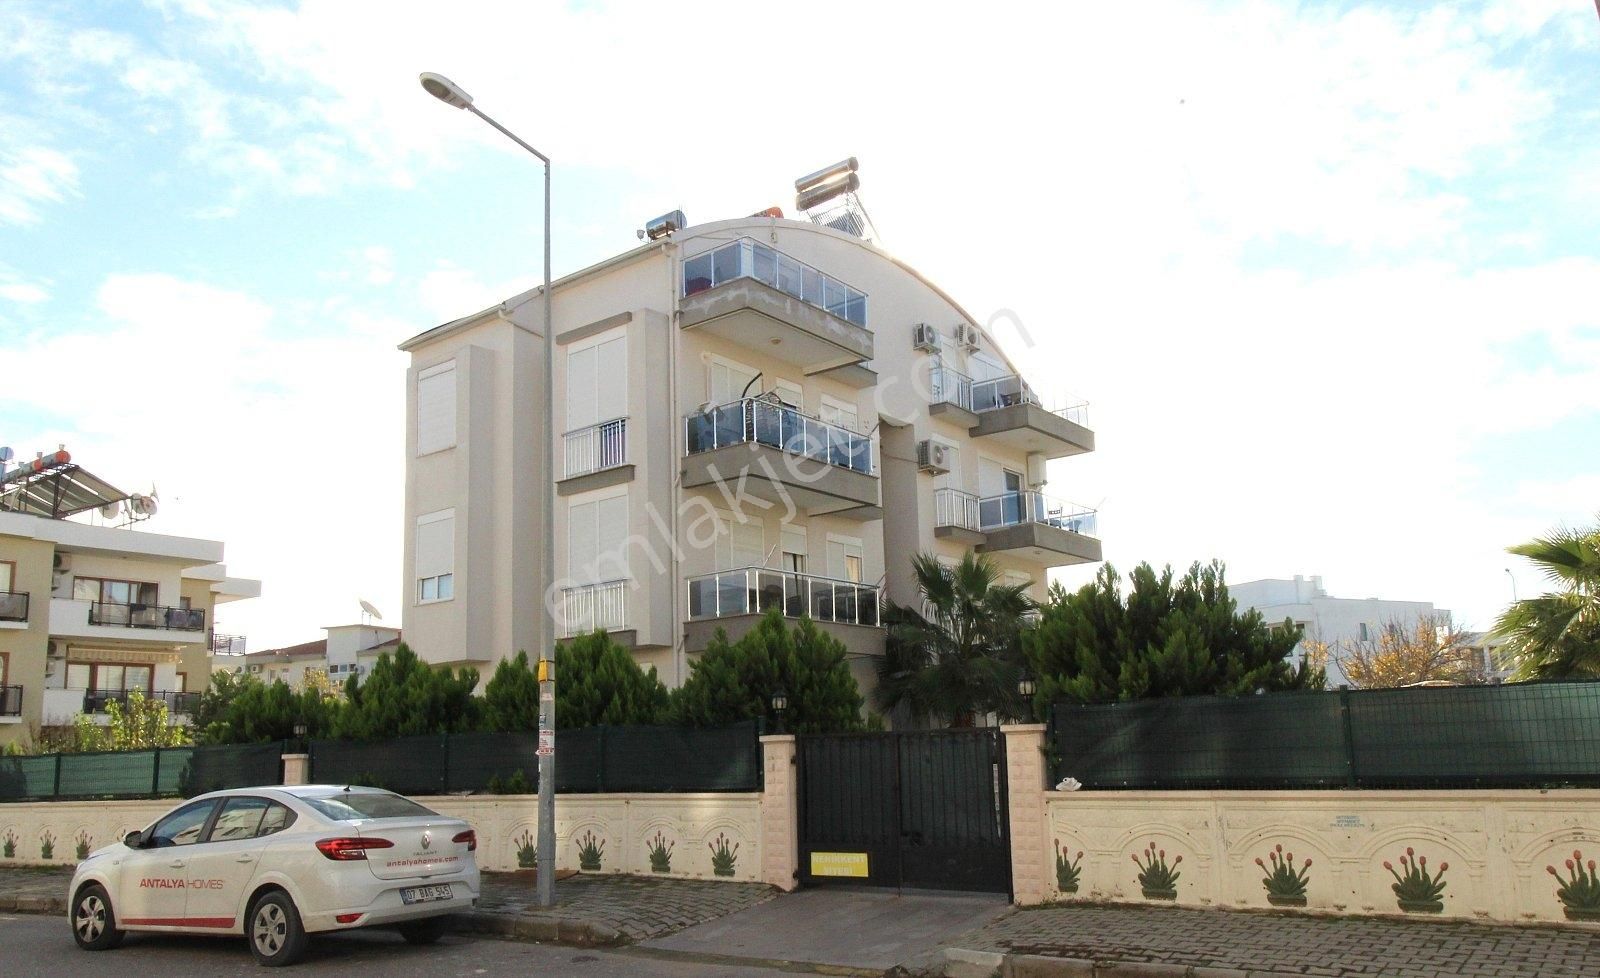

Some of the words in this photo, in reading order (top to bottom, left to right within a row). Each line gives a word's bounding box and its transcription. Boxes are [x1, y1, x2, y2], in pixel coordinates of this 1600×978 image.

[386, 856, 459, 867] antalyahomes.com
[140, 879, 185, 889] ANTALYA
[187, 879, 224, 890] HOMES
[406, 889, 417, 900] 07
[419, 887, 434, 898] BAG
[435, 885, 450, 896] 545
